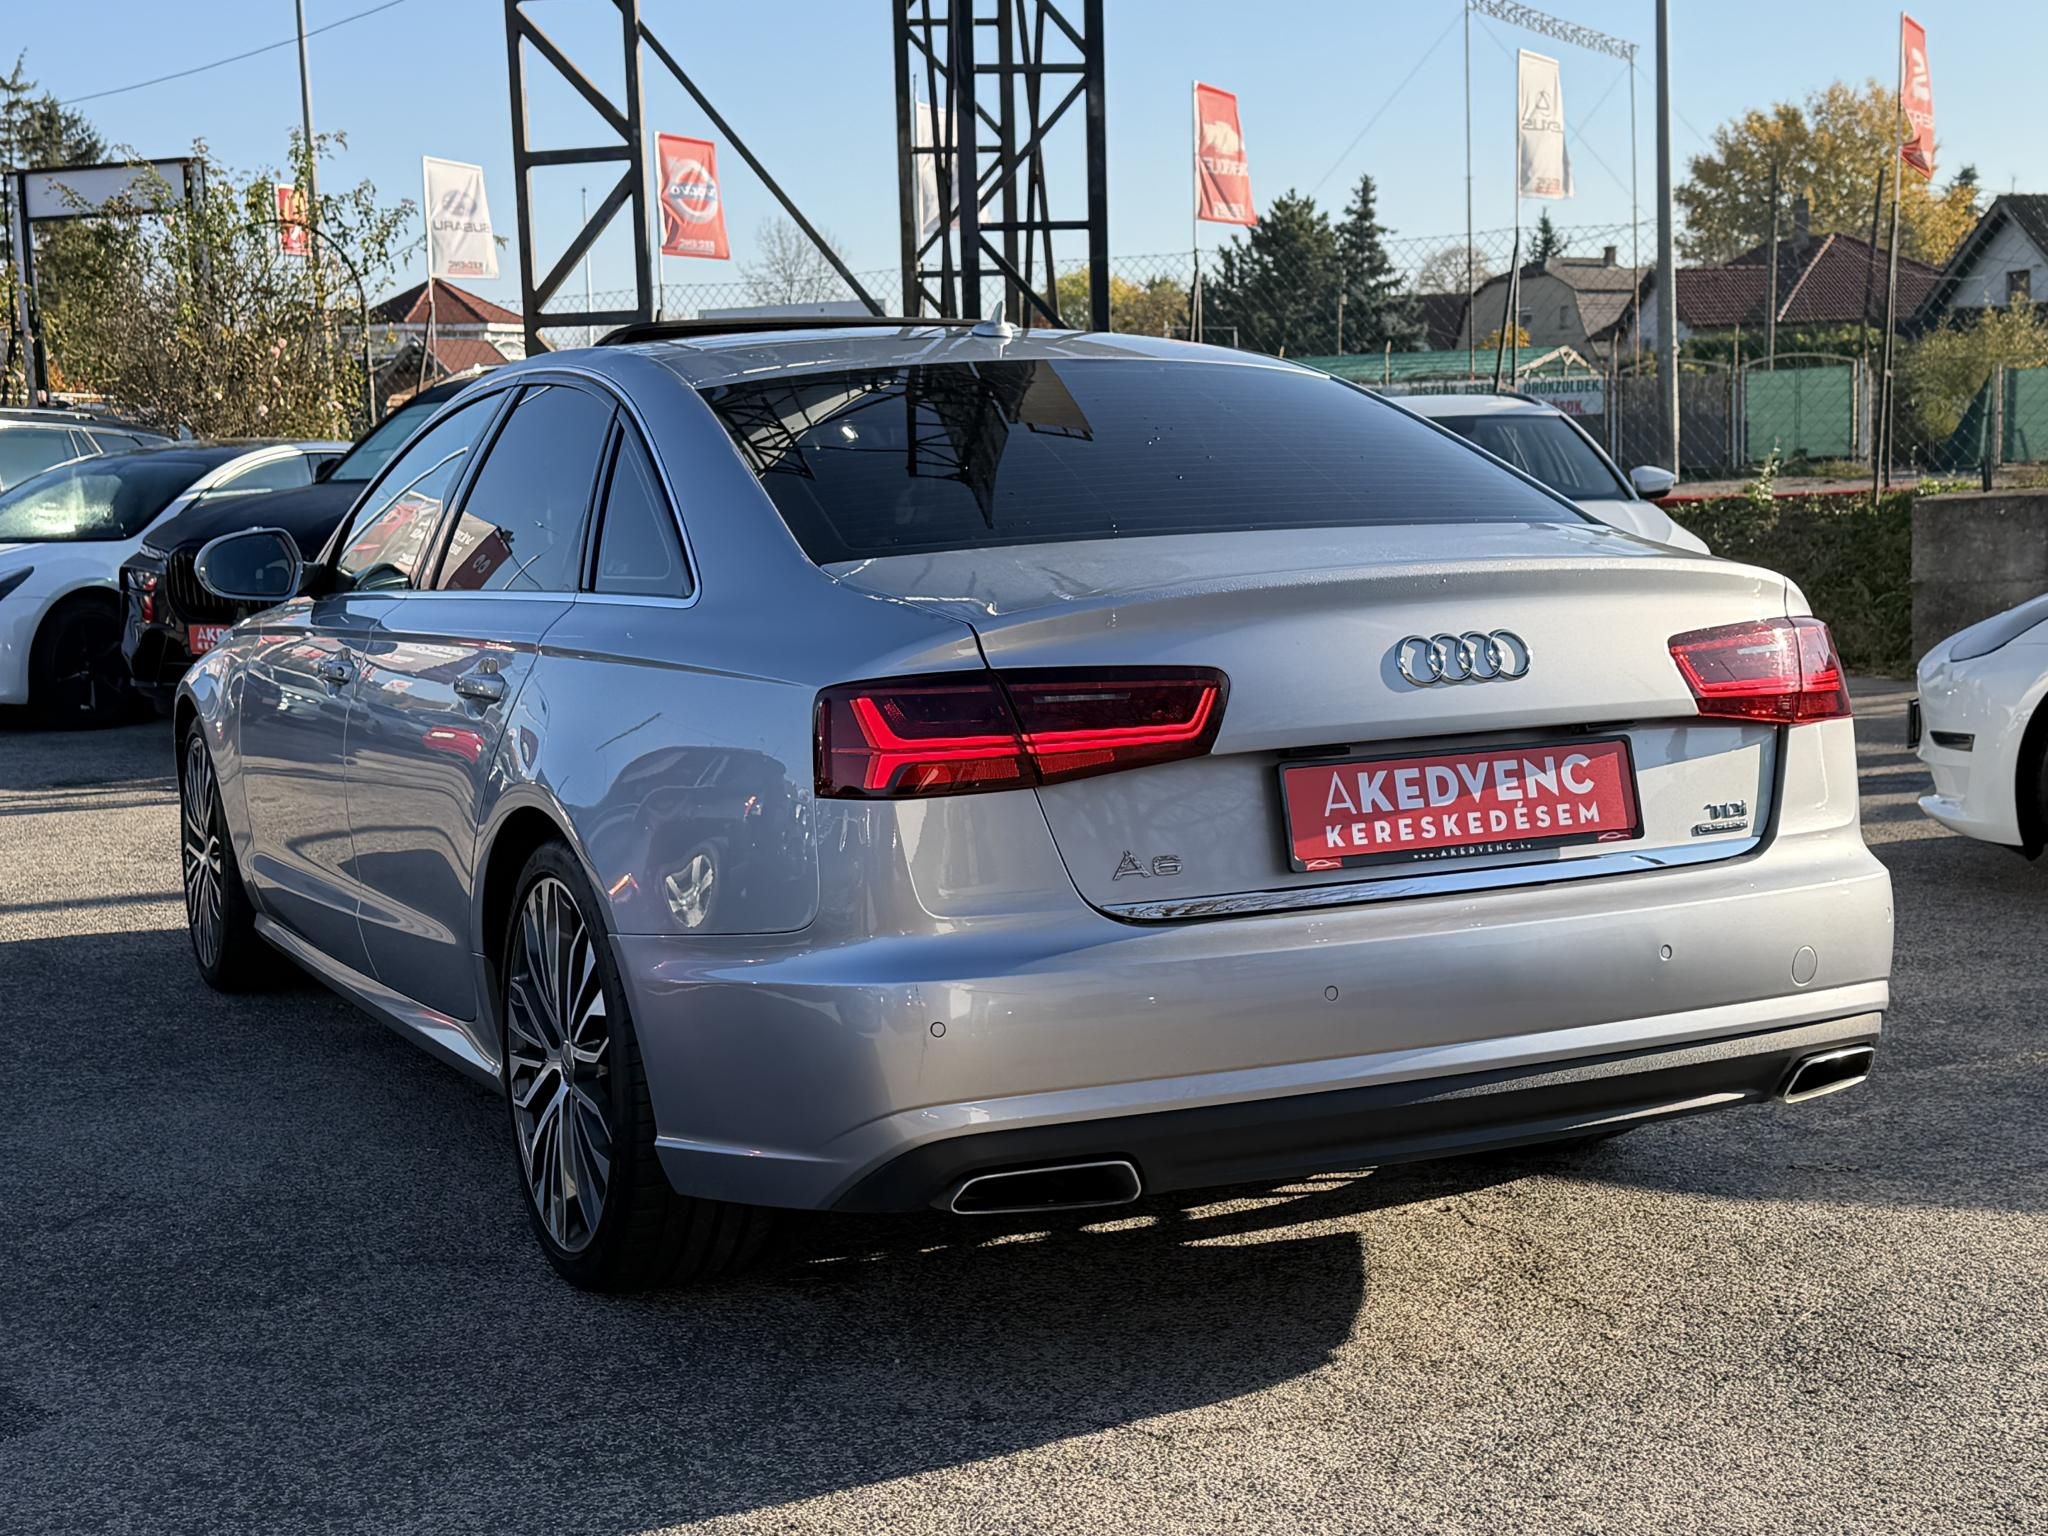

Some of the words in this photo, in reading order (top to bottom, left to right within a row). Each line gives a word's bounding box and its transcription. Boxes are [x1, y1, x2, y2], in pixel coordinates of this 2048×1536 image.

[1325, 753, 1595, 817] AKEDVENC
[1325, 801, 1601, 848] KERESKEDÉSEM
[1112, 850, 1182, 881] A6
